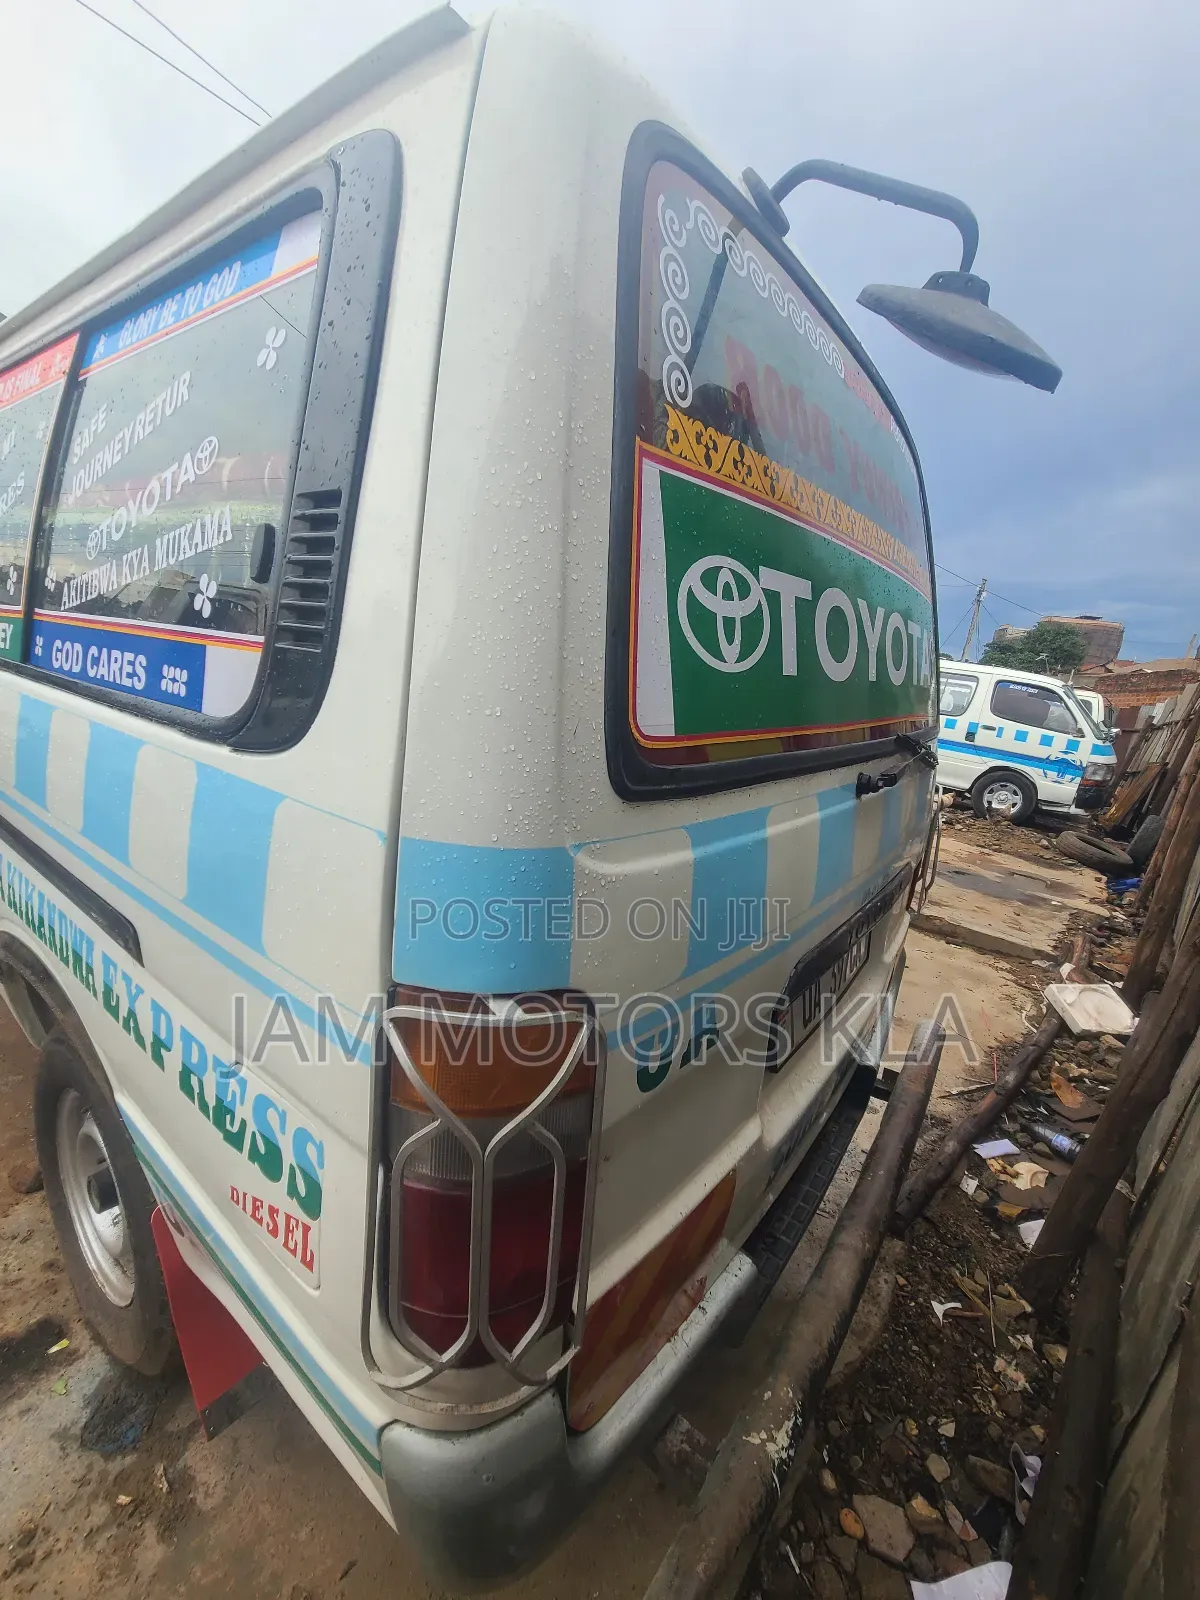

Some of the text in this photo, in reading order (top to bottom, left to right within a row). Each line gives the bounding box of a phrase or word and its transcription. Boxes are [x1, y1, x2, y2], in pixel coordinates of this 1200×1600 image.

[118, 261, 241, 349] GLORY BE TO GOD
[72, 403, 108, 465] SAFE
[99, 451, 196, 552] TOYOTA
[60, 505, 233, 611] AKITIBWA KYA MUKAMA
[52, 639, 147, 690] GOD CARES
[759, 565, 935, 686] TOYOTA
[101, 951, 325, 1222] EXPRESS
[229, 1184, 315, 1274] DIESEL
